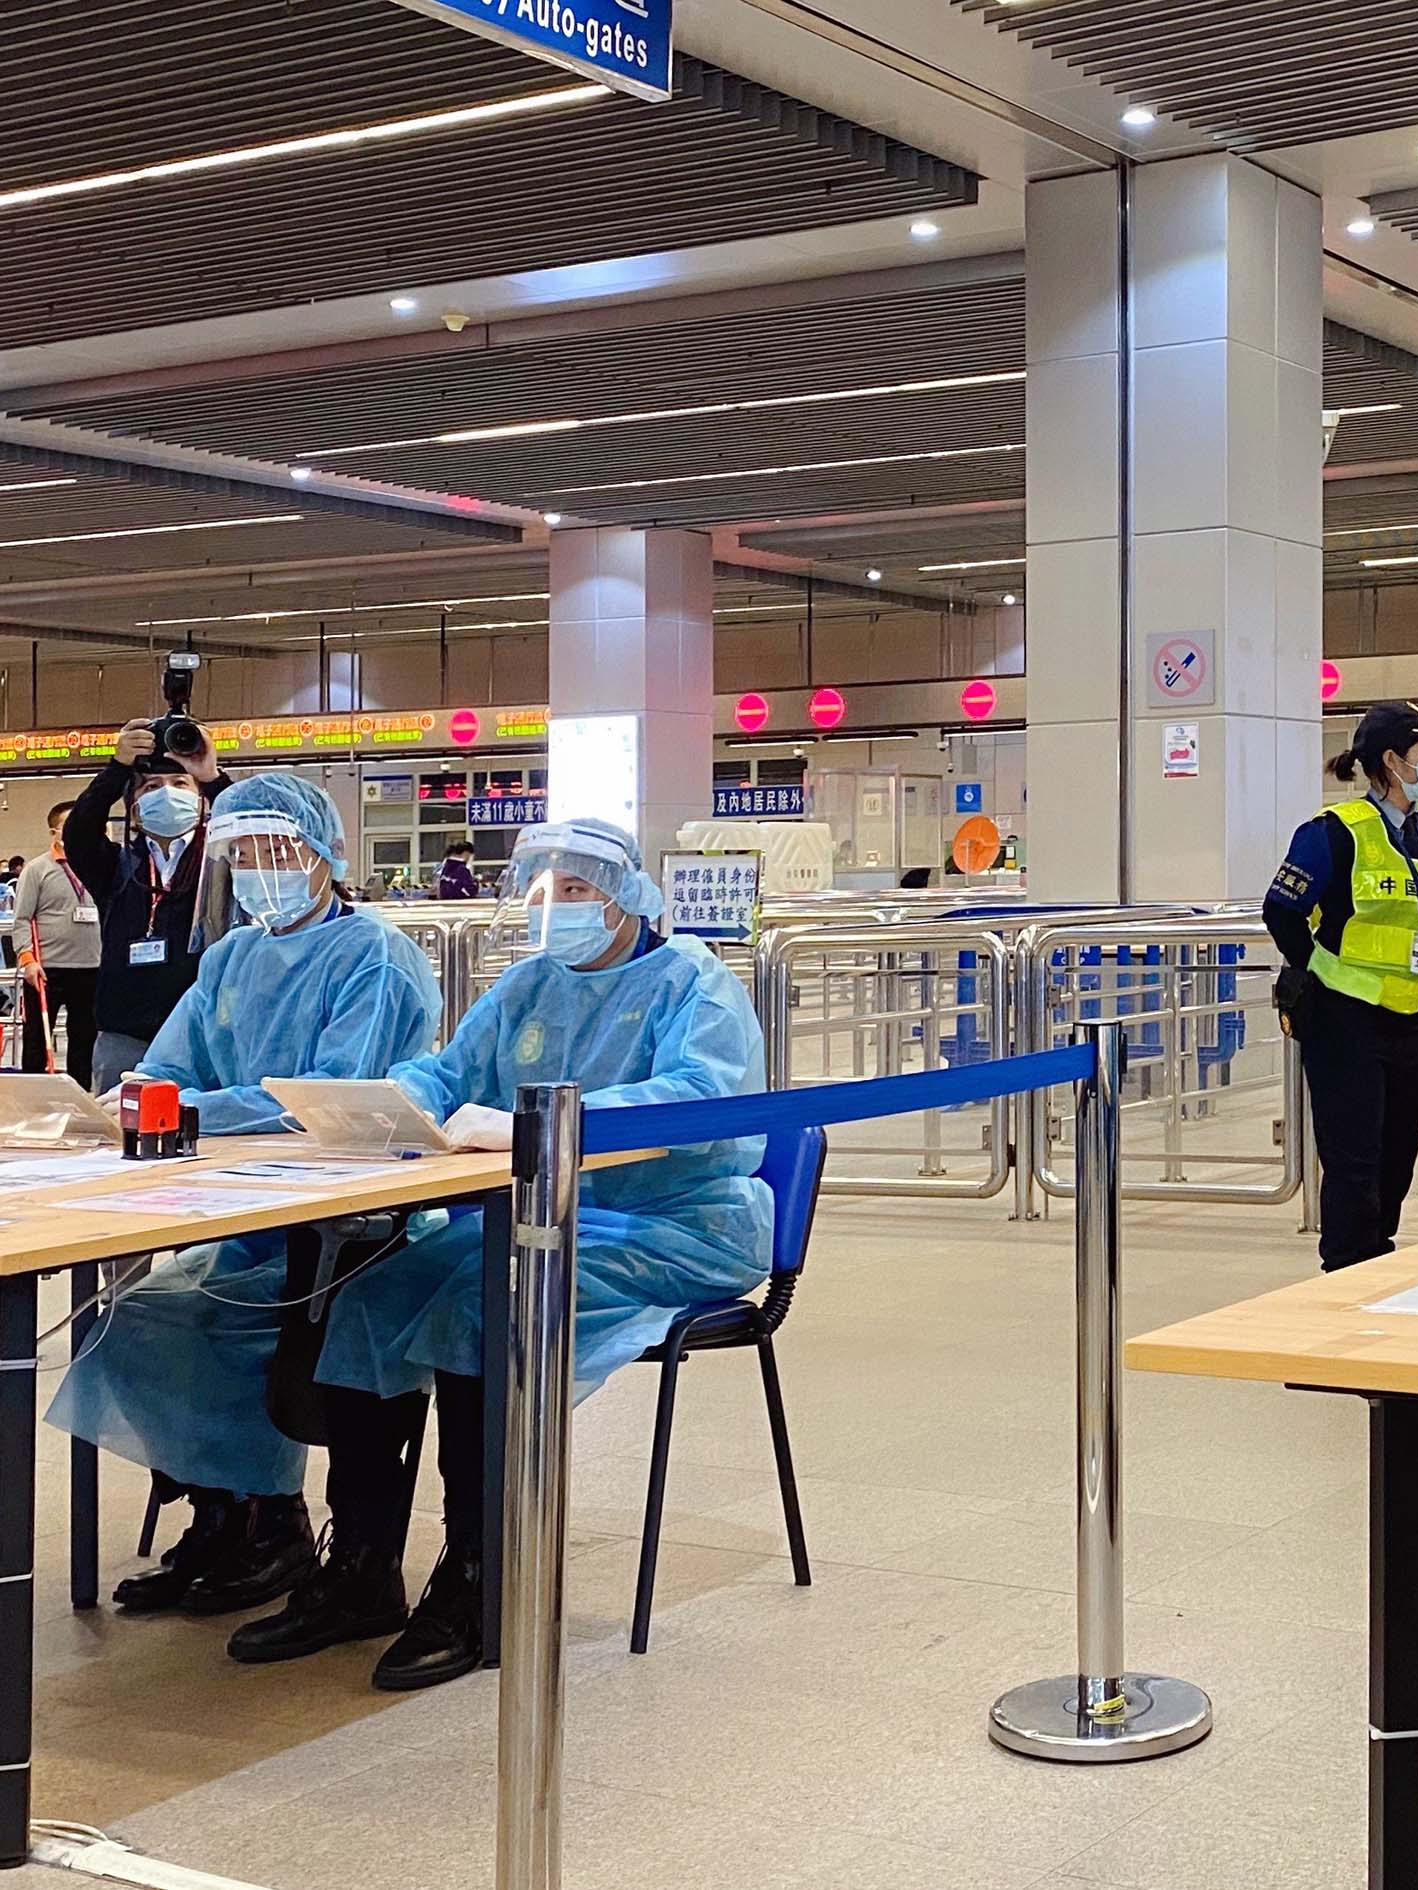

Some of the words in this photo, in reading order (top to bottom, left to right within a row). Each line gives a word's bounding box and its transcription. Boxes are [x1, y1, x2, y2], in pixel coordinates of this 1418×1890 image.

[517, 0, 648, 68] Auto-gates
[471, 800, 545, 824] 未滿11歲小童不
[716, 789, 801, 813] 及內地居民除外
